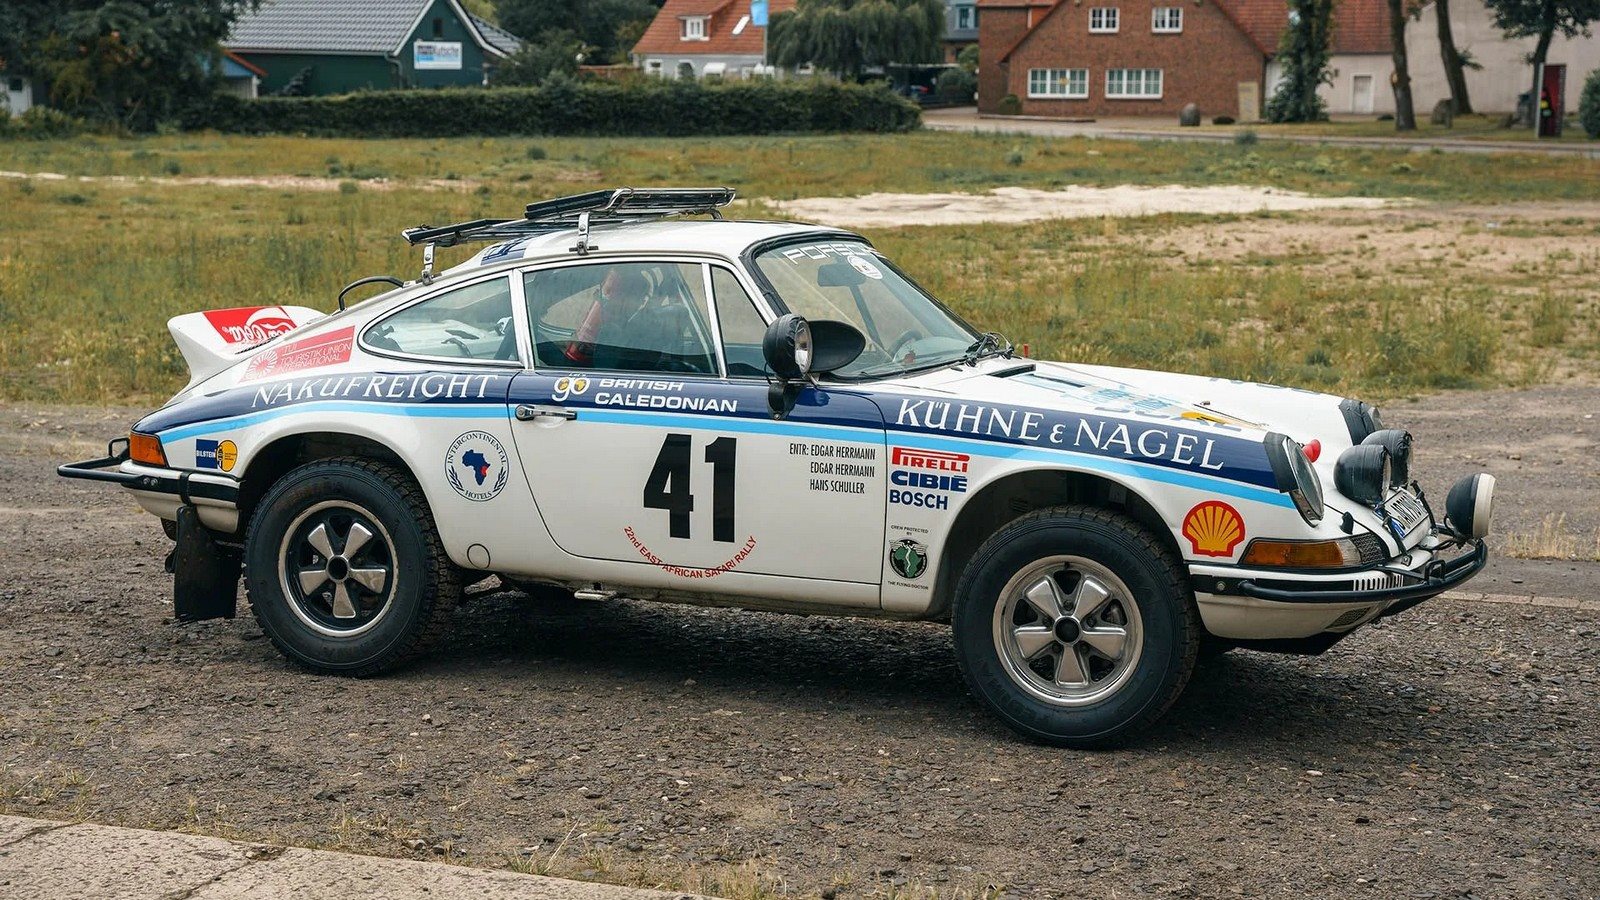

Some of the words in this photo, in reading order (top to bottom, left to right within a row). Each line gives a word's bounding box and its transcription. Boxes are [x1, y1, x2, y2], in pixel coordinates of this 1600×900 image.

[281, 348, 322, 366] TOURISTIK
[323, 342, 352, 356] UNION
[251, 374, 500, 408] NAKUFREIGHT
[551, 376, 590, 402] go
[599, 378, 685, 392] BRITISH
[595, 392, 738, 413] CALEDONIAN
[895, 398, 1045, 442] KÜHNE
[1073, 418, 1225, 471] NAGEL
[447, 432, 507, 464] INTERCONTINENTAL
[789, 443, 809, 456] ENTR:
[811, 444, 834, 457] EDGAR
[836, 446, 876, 460] HERRMANN
[810, 461, 834, 475] EDGAR
[835, 463, 875, 478] HERRMANN
[892, 447, 970, 473] PIRELLI
[464, 489, 492, 500] HOTELS
[643, 432, 738, 543] 41
[809, 479, 829, 492] HANS
[830, 481, 865, 495] SCHULLER
[889, 489, 949, 510] BOSCH
[904, 526, 929, 534] PROTECTED
[624, 526, 641, 549] 22nd
[639, 546, 662, 567] EAST
[662, 563, 704, 579] AFRICAN
[705, 558, 737, 578] SAFARI
[737, 535, 758, 564] RALLY
